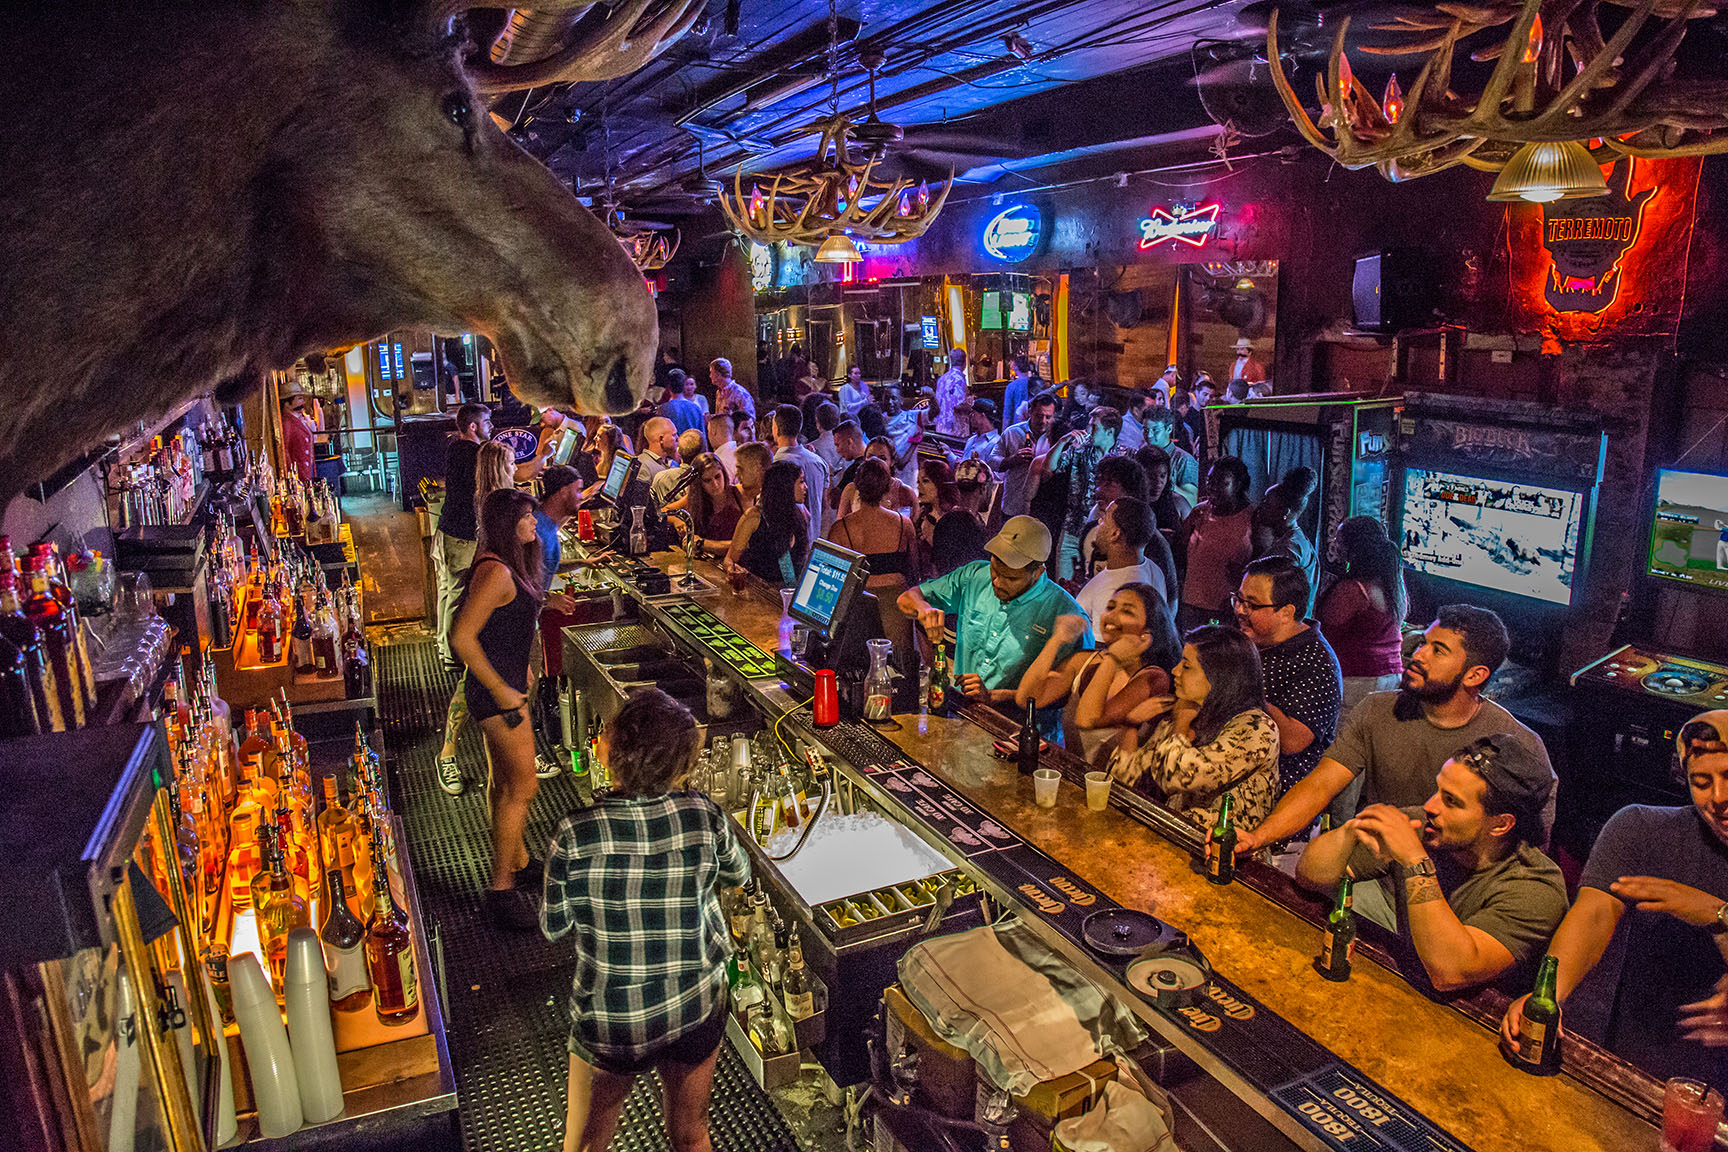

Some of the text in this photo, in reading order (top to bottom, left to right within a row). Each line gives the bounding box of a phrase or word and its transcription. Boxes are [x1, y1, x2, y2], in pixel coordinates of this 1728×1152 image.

[1547, 216, 1633, 243] TERREMOTO
[514, 430, 533, 442] STAR
[1320, 1098, 1363, 1132] TEQUILA
[1332, 1086, 1391, 1128] 1800
[1354, 1083, 1397, 1116] TEQUILA
[1297, 1101, 1356, 1144] 1800
